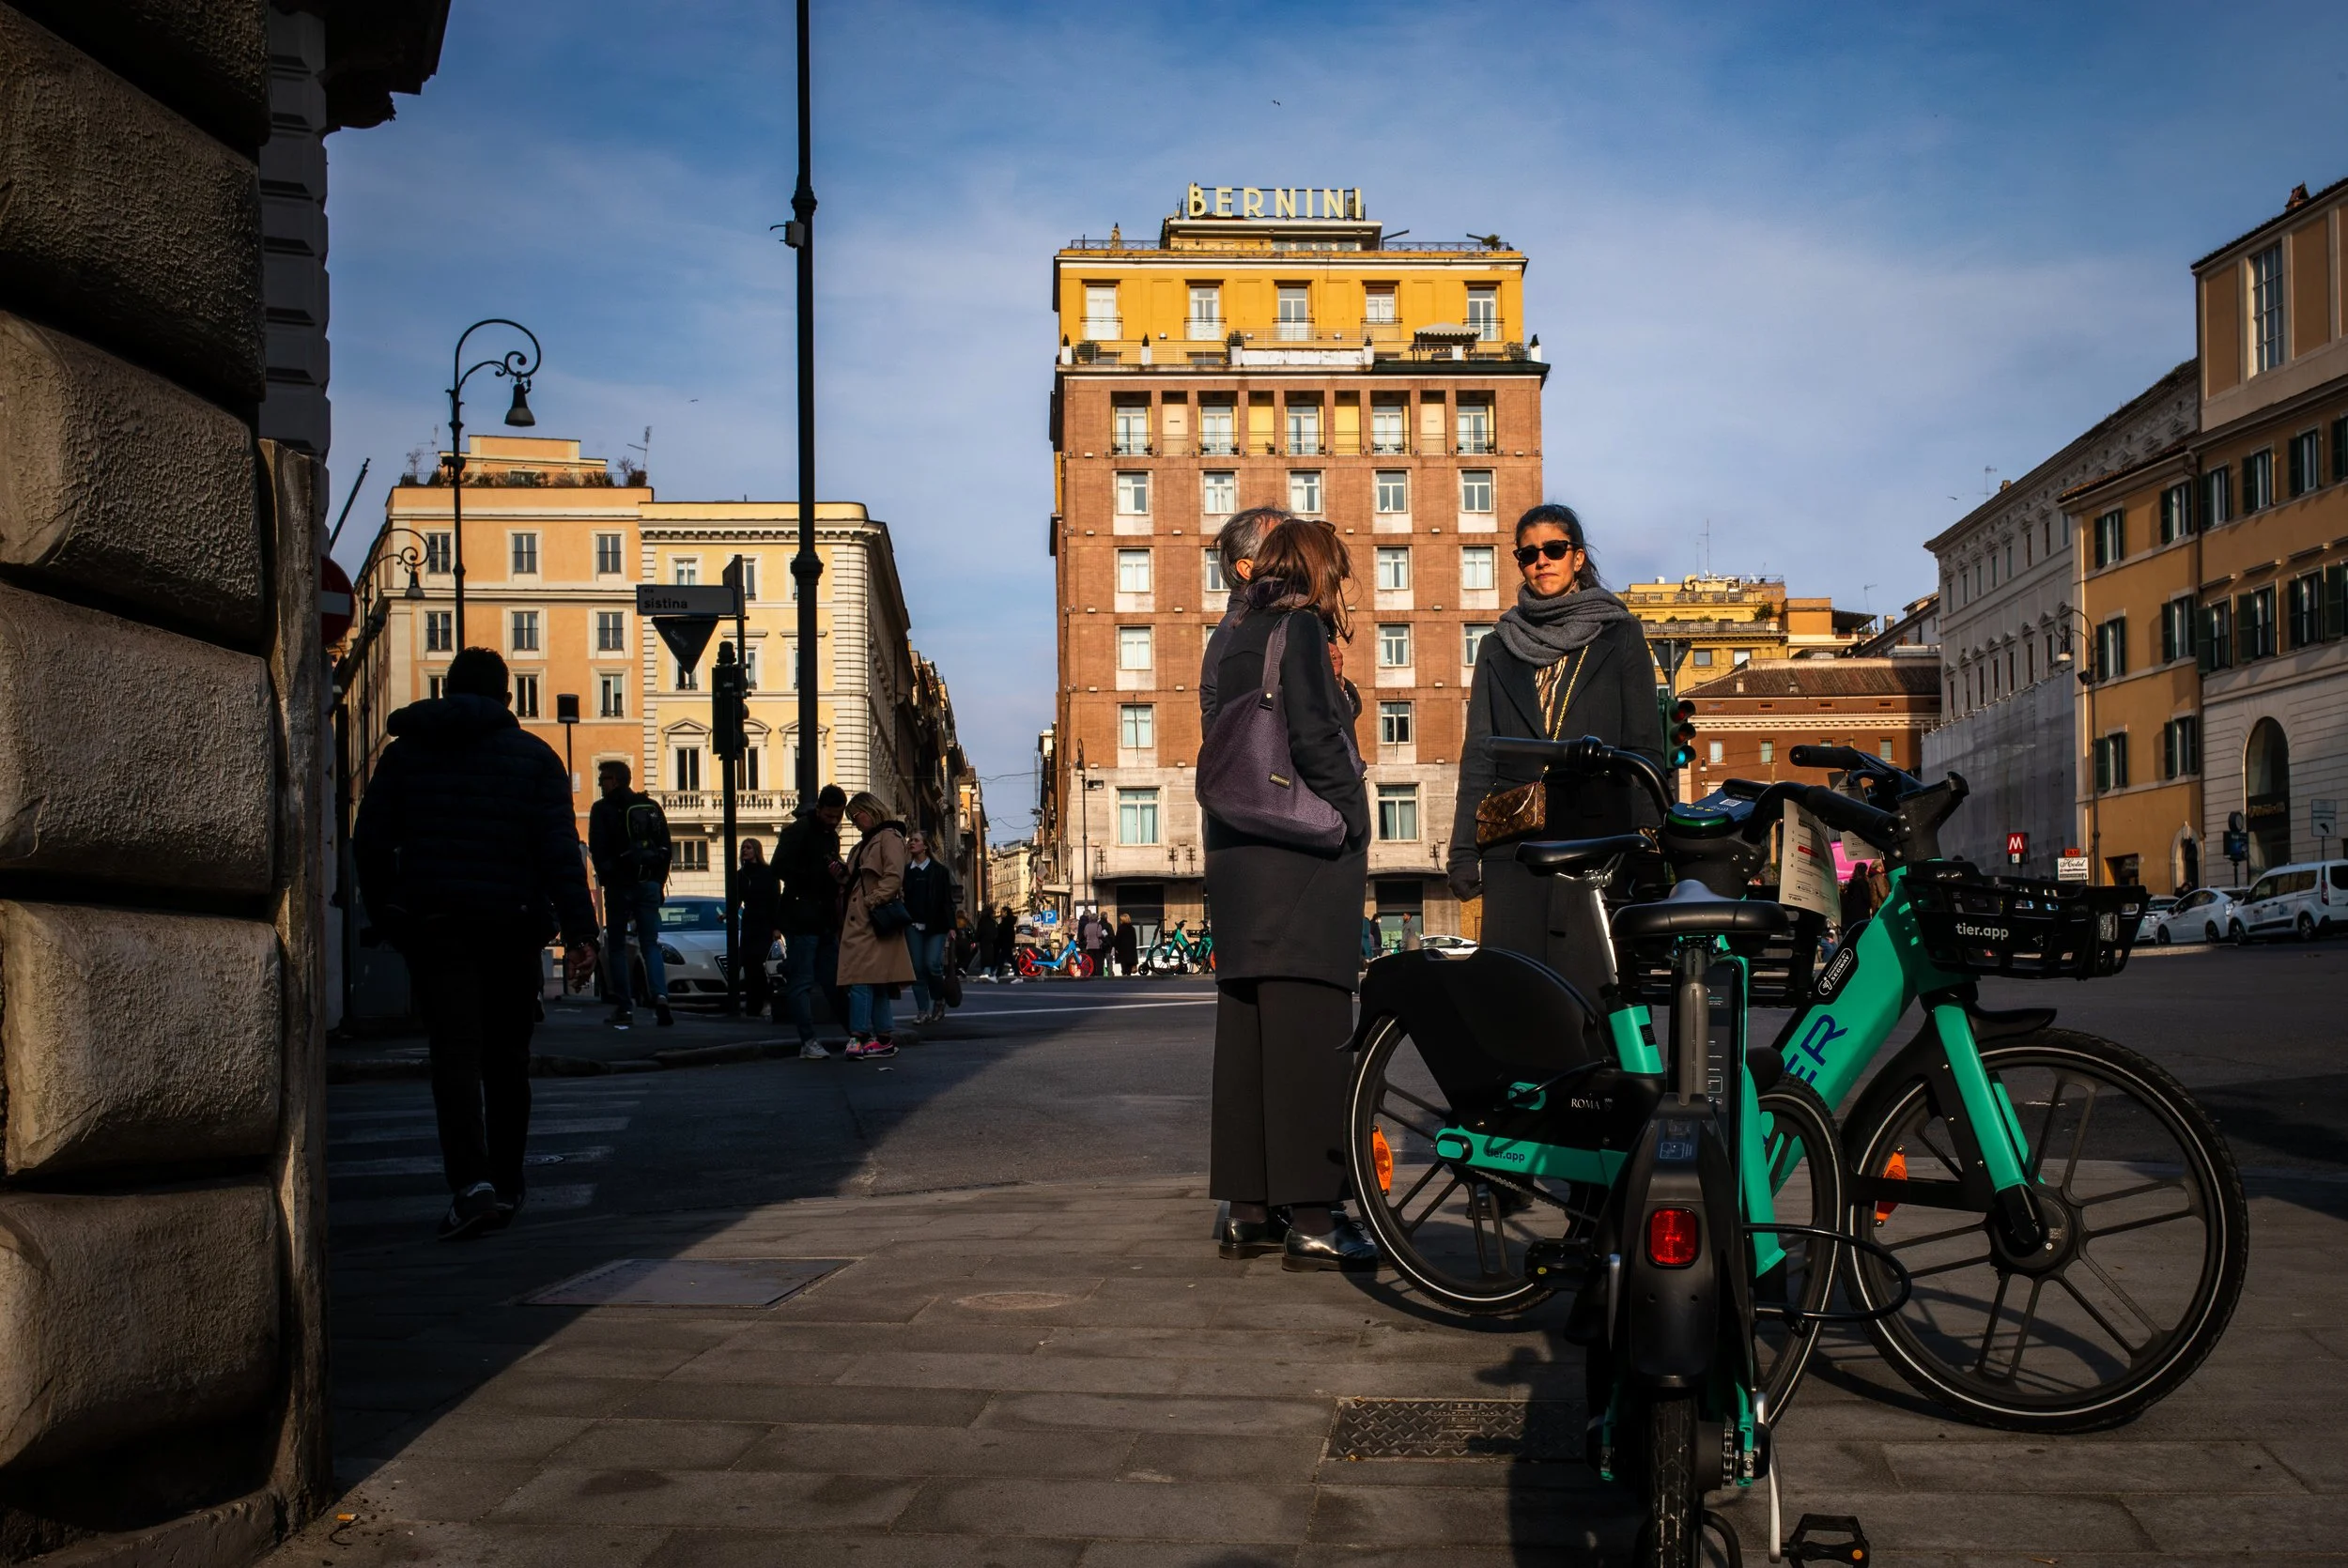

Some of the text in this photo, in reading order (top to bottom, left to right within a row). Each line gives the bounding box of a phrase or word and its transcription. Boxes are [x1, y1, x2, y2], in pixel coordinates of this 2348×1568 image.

[1188, 186, 1362, 219] BERNINI
[643, 598, 687, 609] sistina
[2008, 836, 2023, 851] M
[2059, 858, 2086, 869] Hotel
[1045, 912, 1054, 923] P
[1955, 922, 2010, 941] tier.app
[1831, 954, 1849, 982] SEGWAY
[1570, 1098, 1600, 1111] ROMA
[1486, 1146, 1526, 1162] tier.app
